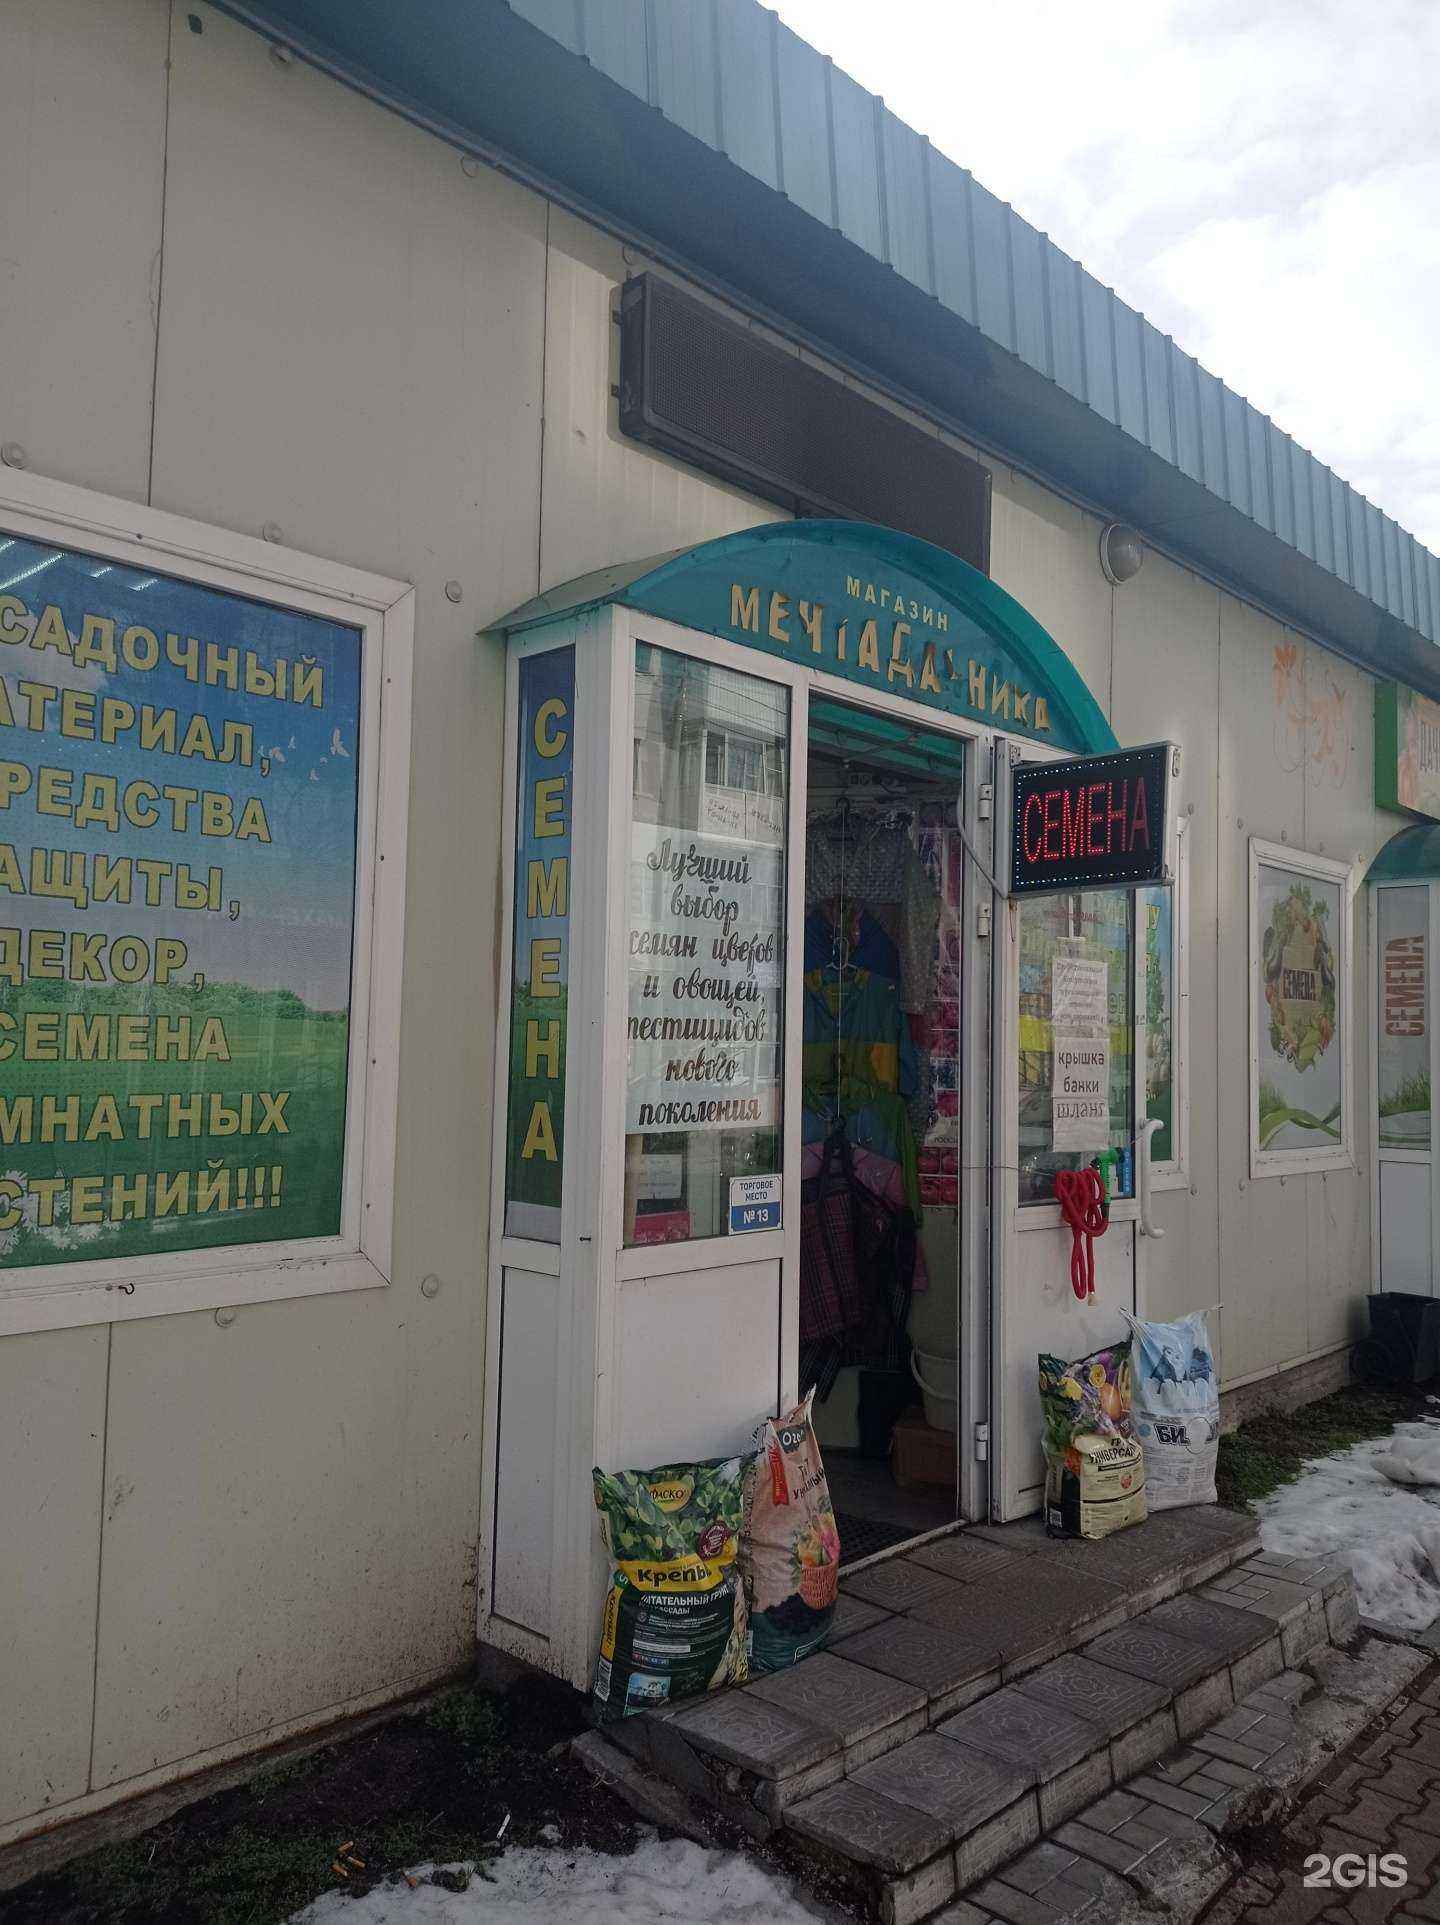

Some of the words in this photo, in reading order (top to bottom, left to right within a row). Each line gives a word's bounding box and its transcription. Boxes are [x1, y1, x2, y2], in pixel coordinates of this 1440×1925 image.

[846, 575, 949, 632] МАГАЗИН
[0, 595, 324, 709] САДОЧНЫЙ
[0, 758, 272, 843] РЕДСТВА
[1022, 776, 1150, 863] СЕМЕНА
[646, 838, 752, 884] Лучший
[520, 697, 569, 1162] СЕМЕНА
[670, 884, 739, 937] выбор
[629, 930, 698, 959] семян
[642, 974, 661, 998] и
[1384, 935, 1425, 1036] СЕМЕНА
[665, 1048, 740, 1082] нового
[1057, 1051, 1105, 1069] крышка
[1063, 1076, 1099, 1093] банки
[0, 1092, 290, 1144] МНАТНЫХ
[638, 1098, 762, 1126] поколения
[739, 1180, 774, 1191] ТОРГОВОЕ
[745, 1191, 768, 1201] МЕСТО
